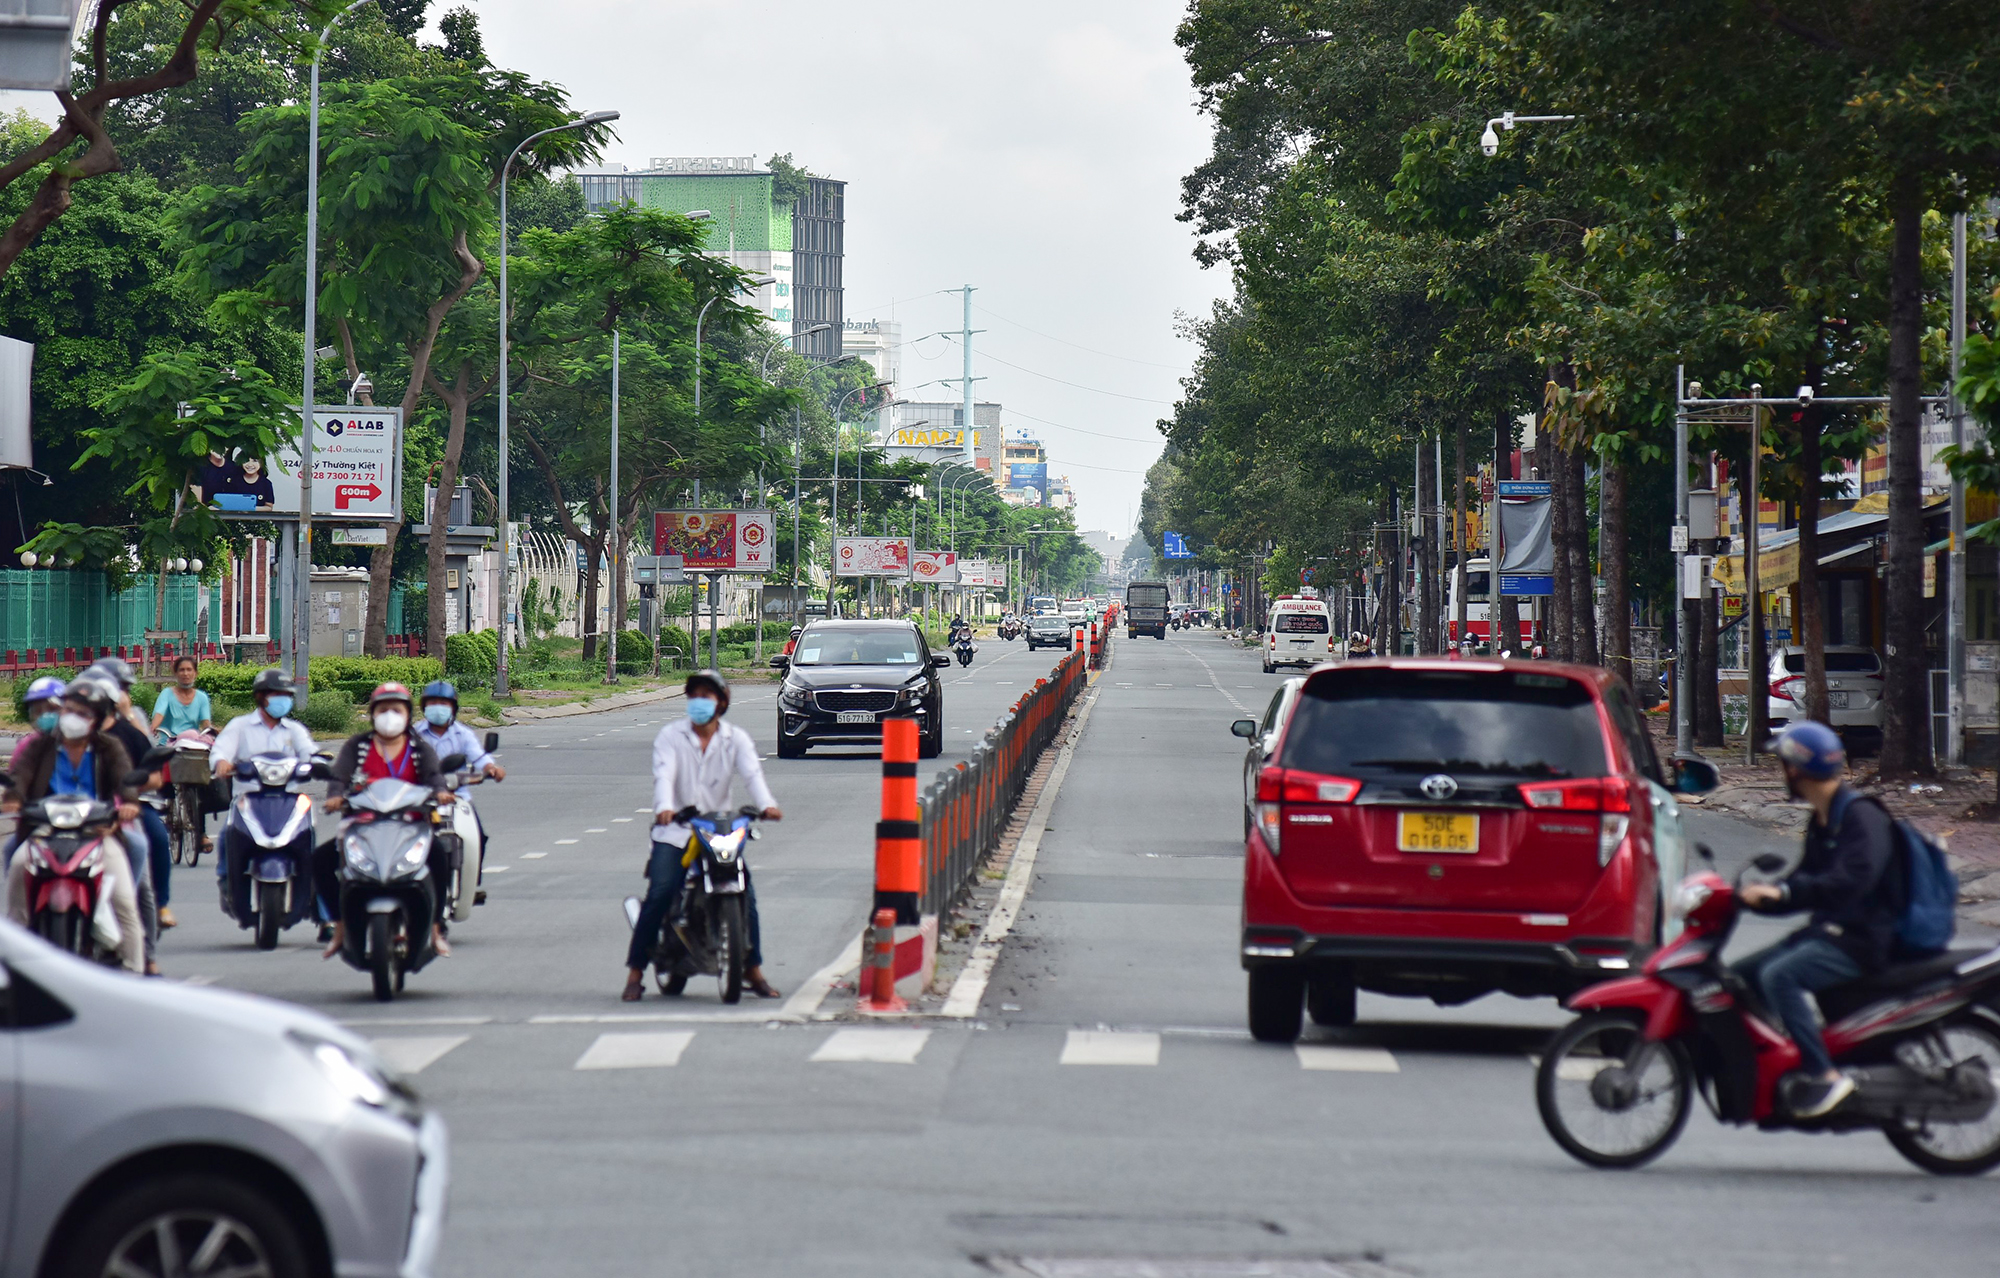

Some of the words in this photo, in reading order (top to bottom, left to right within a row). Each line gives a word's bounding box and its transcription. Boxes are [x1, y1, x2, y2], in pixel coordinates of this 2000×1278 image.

[347, 420, 384, 430] ALAB
[898, 430, 950, 446] NAM
[327, 445, 342, 454] 4.0
[323, 460, 356, 471] Thường
[358, 461, 376, 472] Kiệt
[327, 472, 349, 481] 7300
[351, 473, 362, 481] 71
[364, 473, 376, 481] 72
[341, 488, 370, 496] 600m
[746, 553, 761, 561] XV
